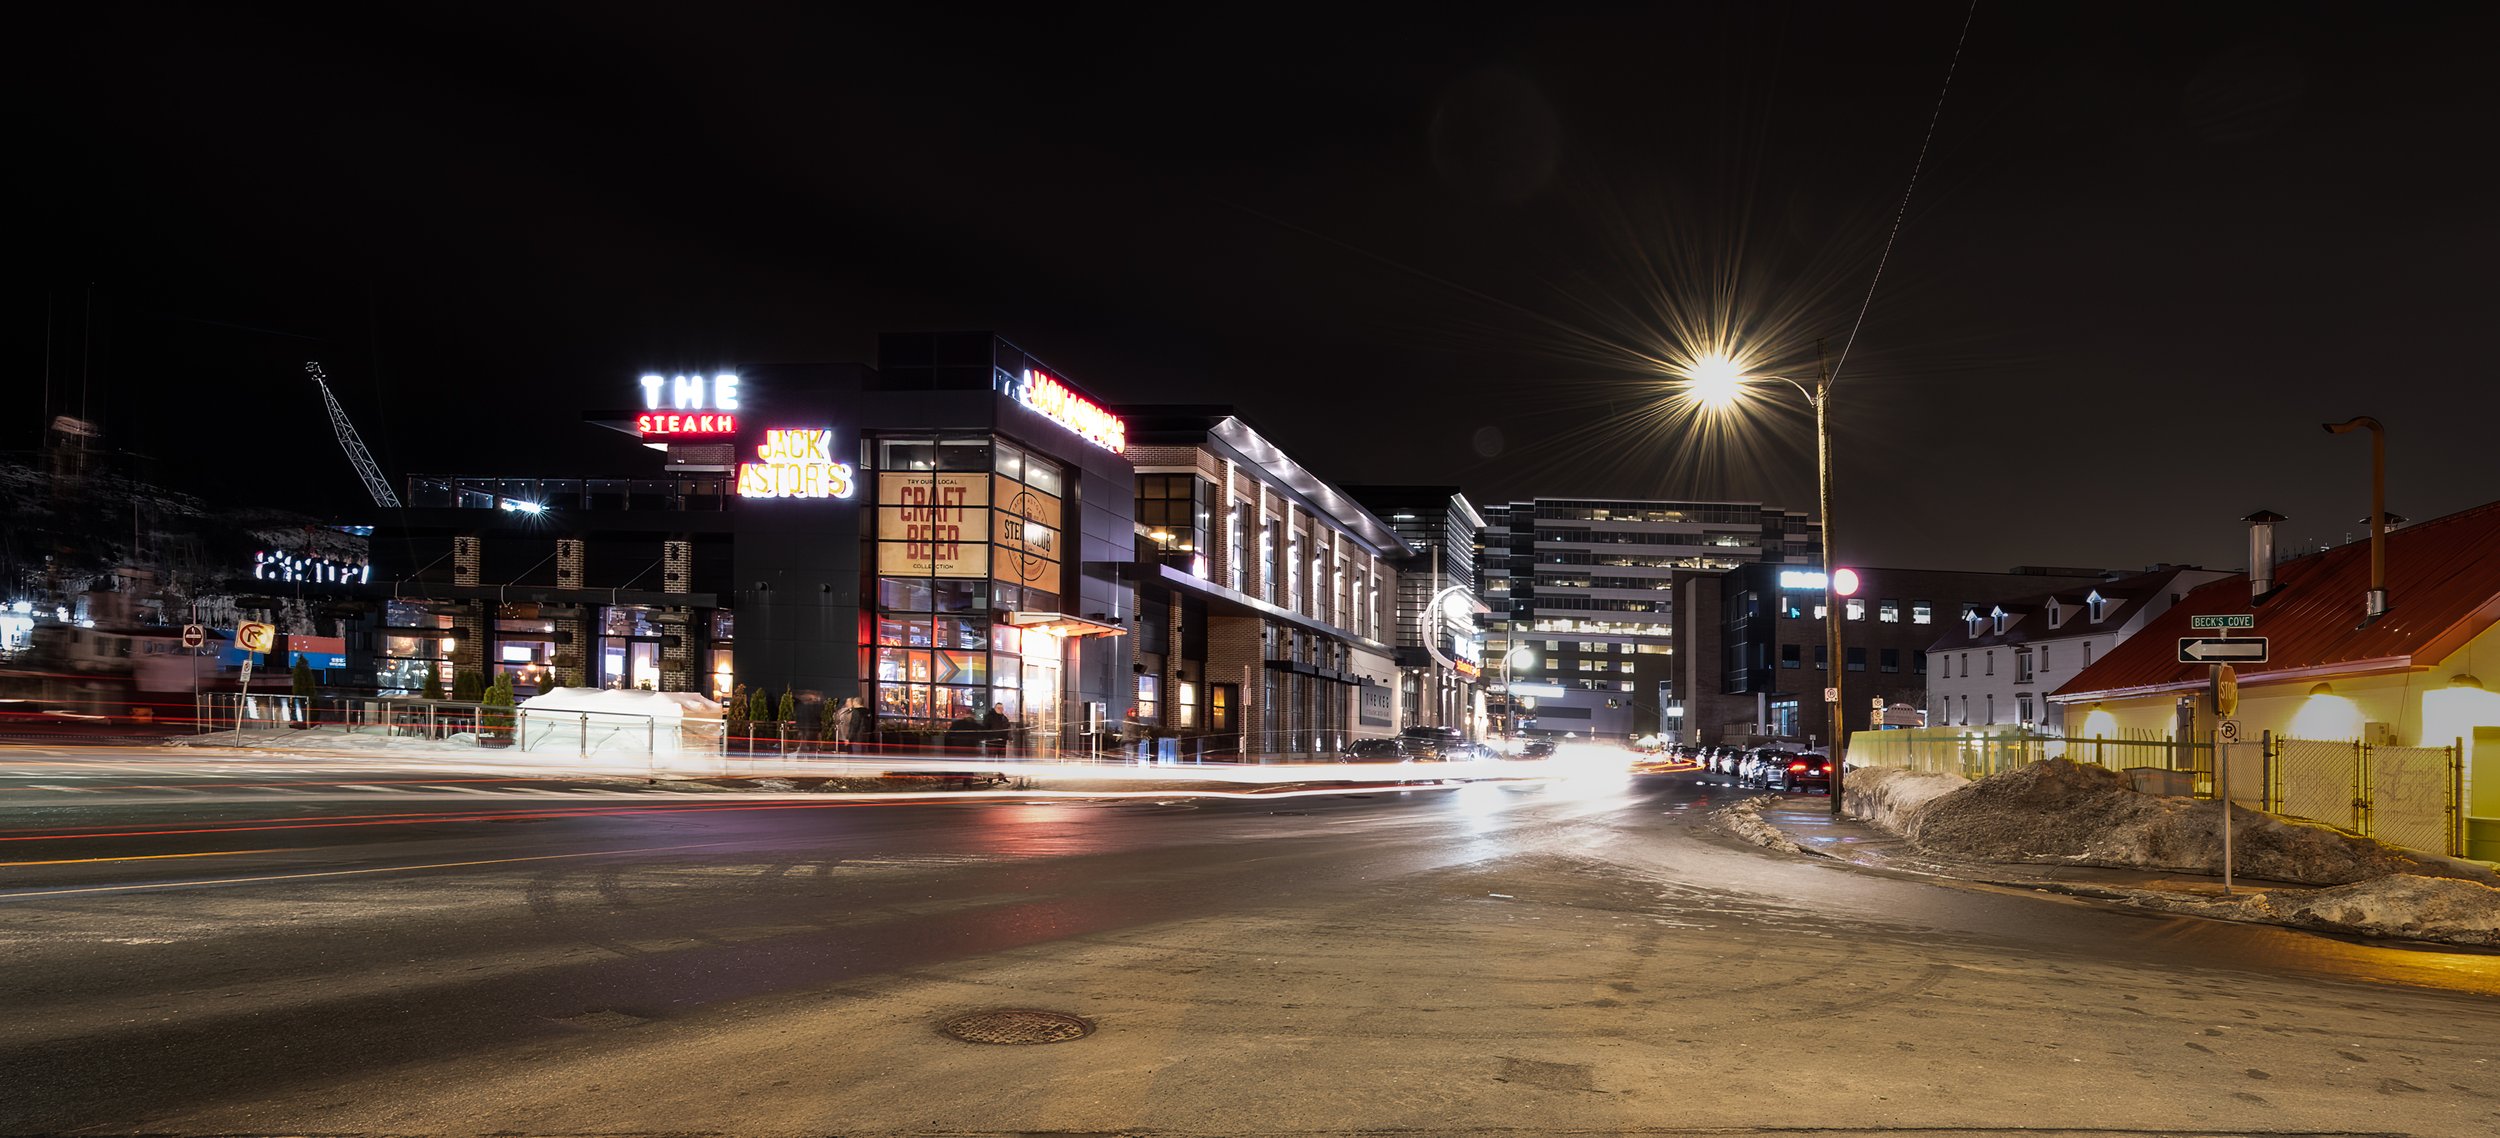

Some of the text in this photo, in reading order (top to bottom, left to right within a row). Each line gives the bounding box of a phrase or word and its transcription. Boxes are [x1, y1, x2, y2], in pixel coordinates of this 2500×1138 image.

[641, 375, 739, 410] THE
[639, 415, 732, 432] STEAKH
[757, 429, 832, 461] JACK
[900, 486, 967, 523] CRAFT
[906, 524, 960, 561] BEER
[2194, 616, 2251, 627] BECK'S COVE
[2220, 681, 2236, 700] STOP
